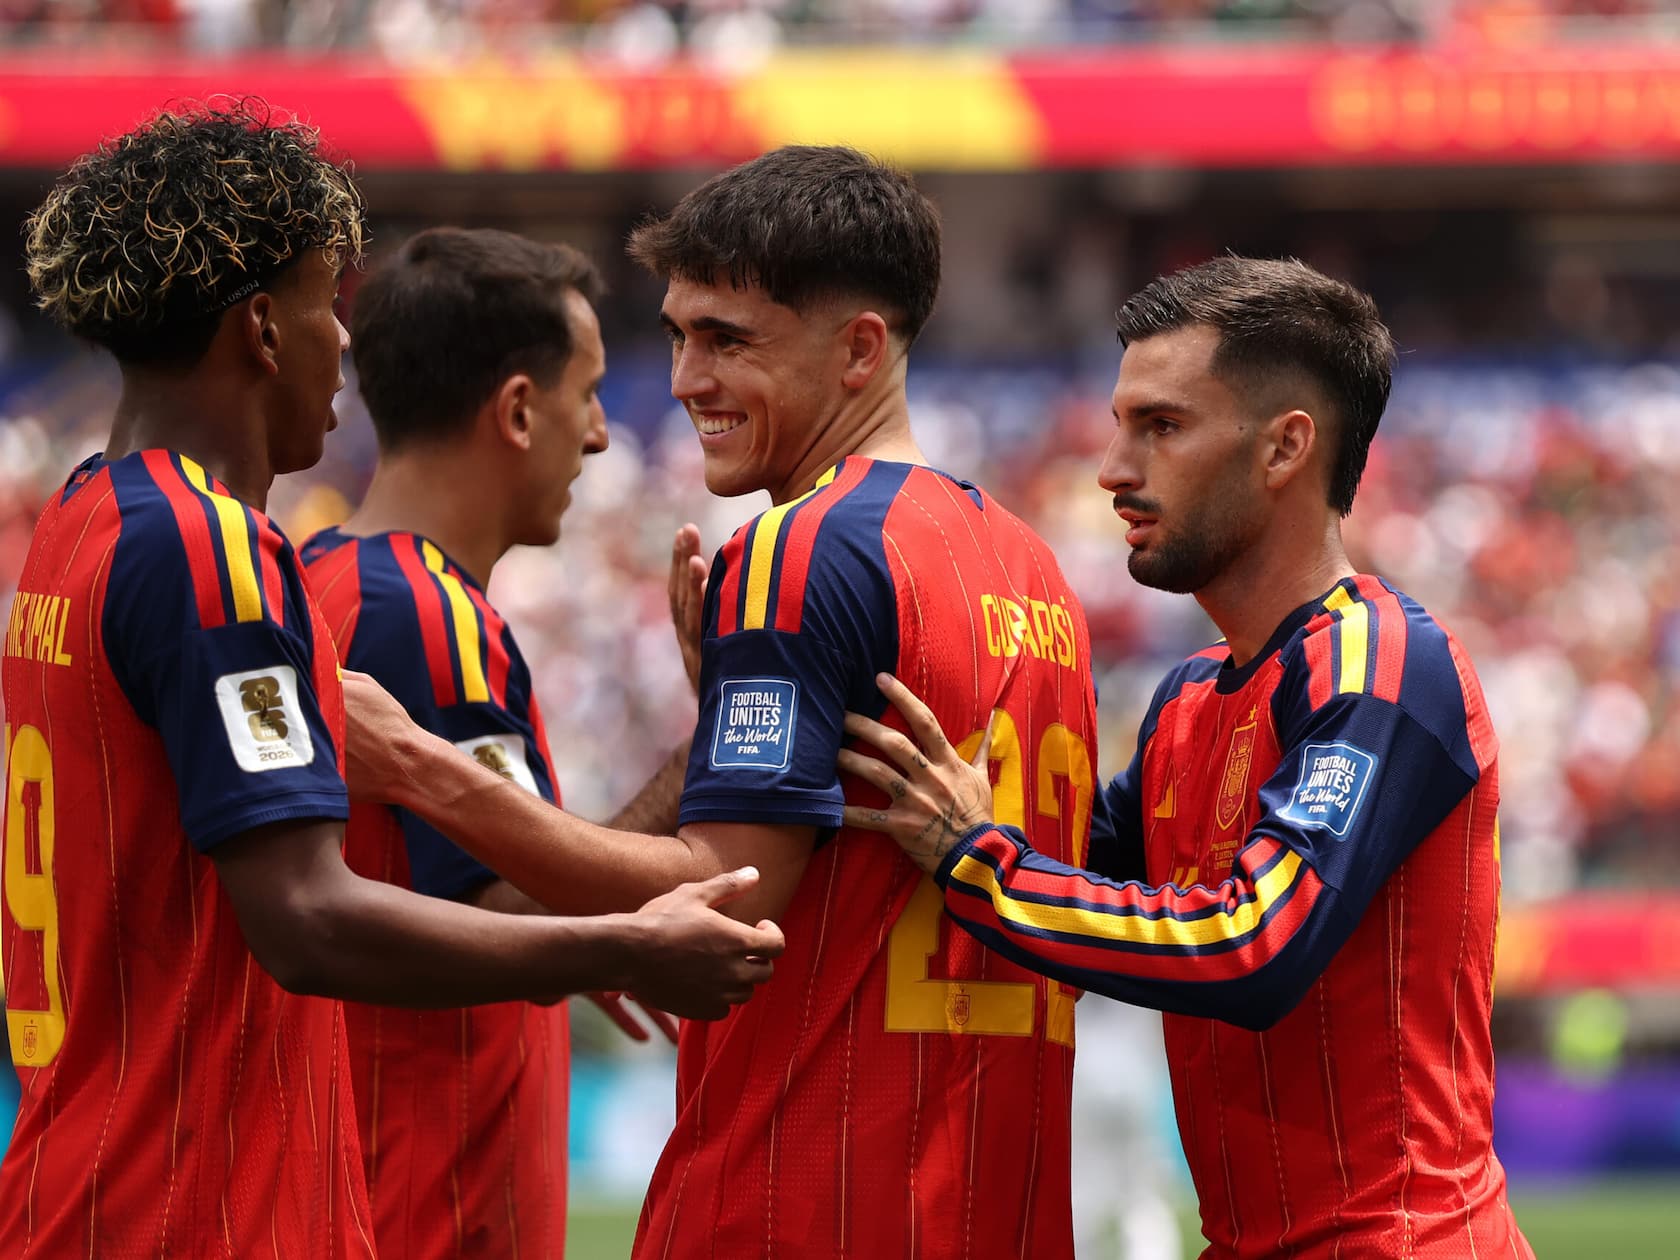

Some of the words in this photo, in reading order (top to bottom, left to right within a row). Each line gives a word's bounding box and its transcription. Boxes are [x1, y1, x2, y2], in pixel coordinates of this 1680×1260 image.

[731, 692, 782, 707] FOOTBALL
[728, 707, 781, 726] UNITES
[723, 728, 744, 744] the
[744, 726, 783, 745] World
[258, 750, 294, 762] 2026
[737, 745, 760, 754] FIFA
[1313, 755, 1356, 777] FOOTBALL
[1307, 768, 1354, 794] UNITES
[1299, 788, 1315, 804] the
[1314, 787, 1350, 813] World
[1308, 804, 1328, 814] FIFA
